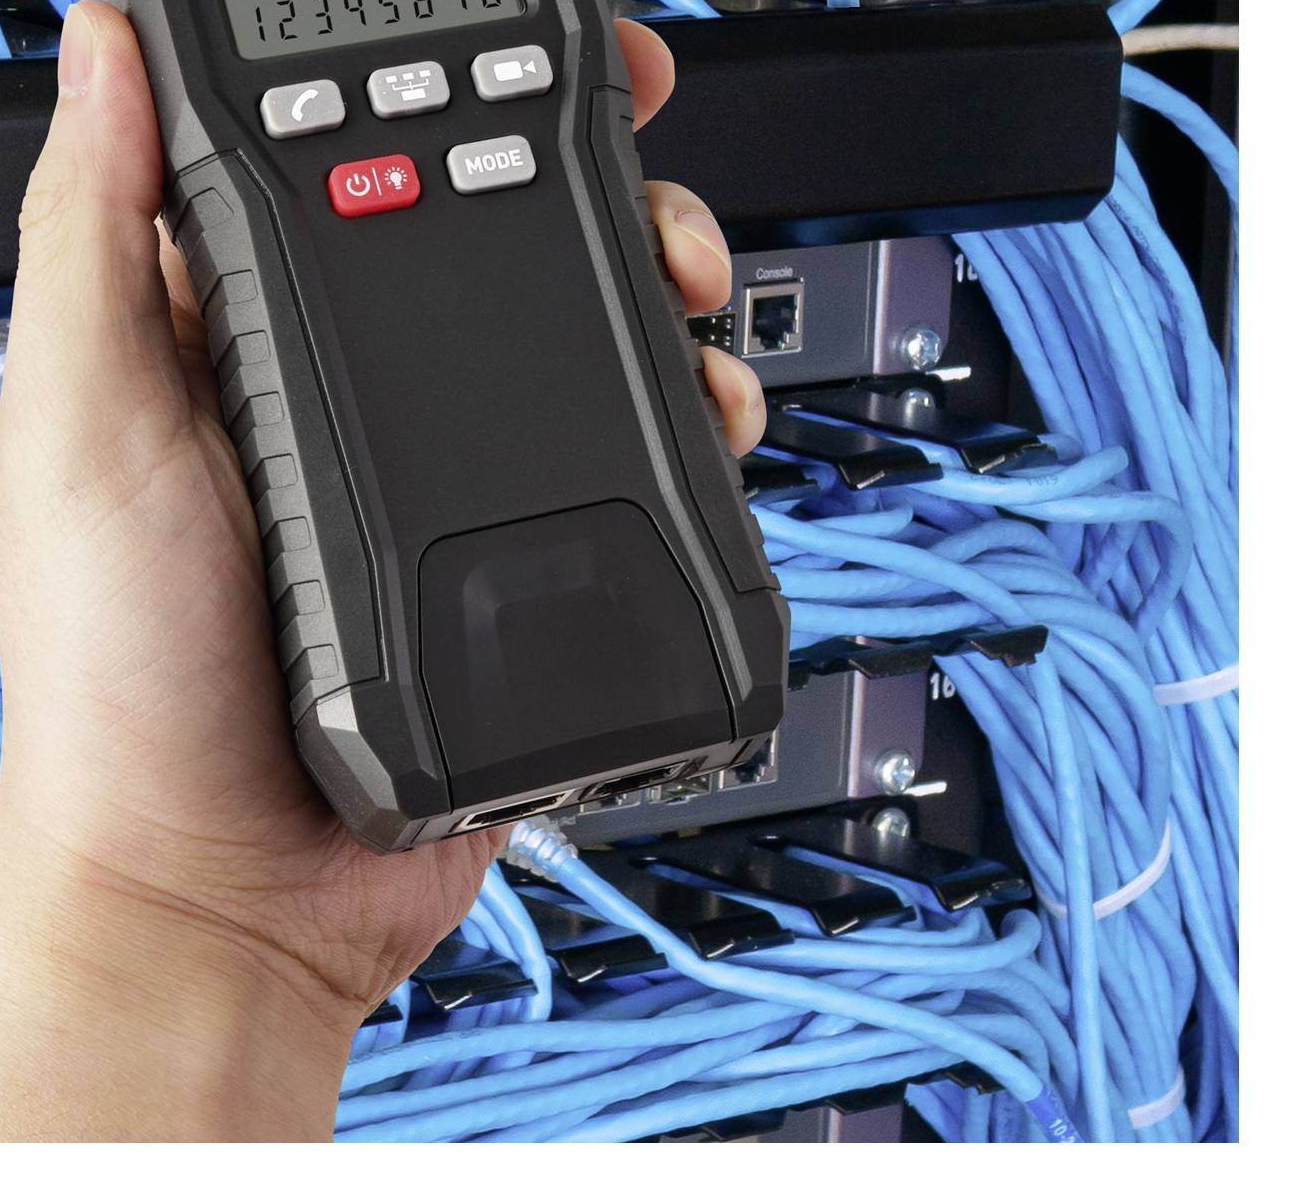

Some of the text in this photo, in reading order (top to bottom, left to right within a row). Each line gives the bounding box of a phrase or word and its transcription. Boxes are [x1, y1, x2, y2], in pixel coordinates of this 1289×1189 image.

[255, 6, 266, 41] 1
[277, 0, 298, 40] 2
[464, 148, 524, 176] MODE
[755, 266, 794, 280] Console
[930, 672, 956, 701] 16
